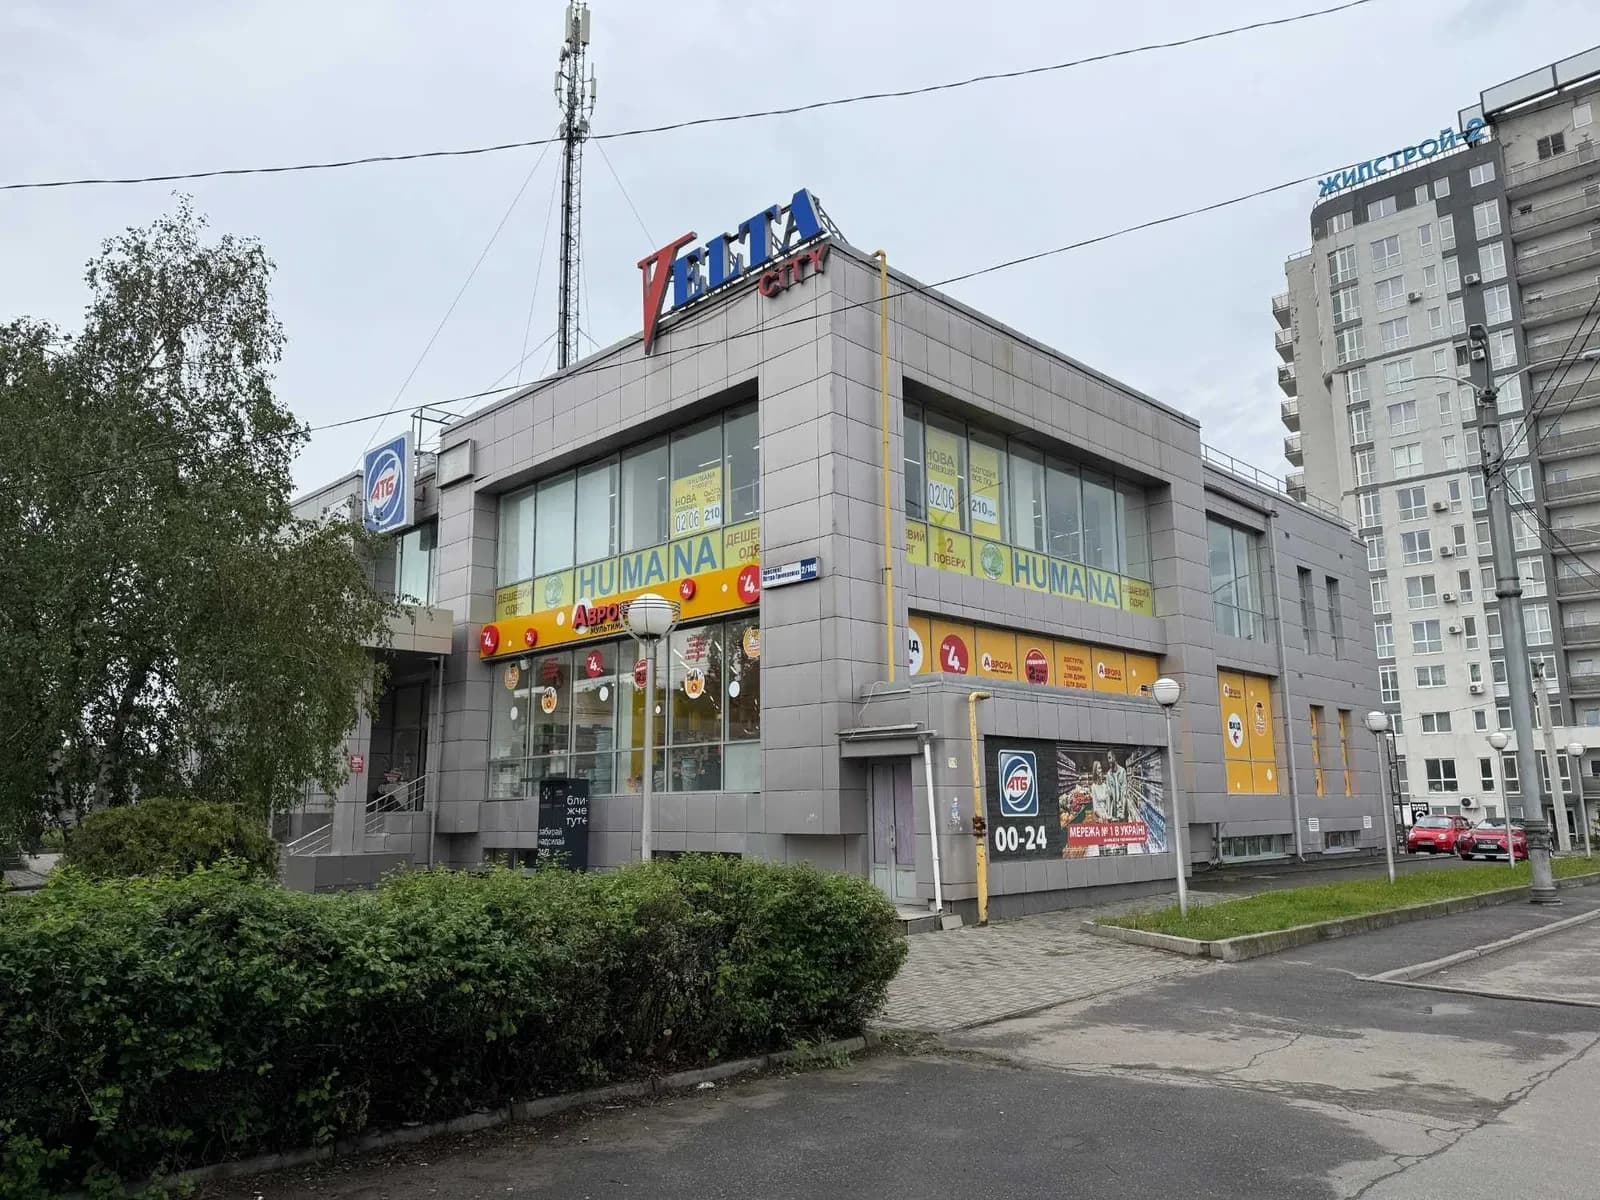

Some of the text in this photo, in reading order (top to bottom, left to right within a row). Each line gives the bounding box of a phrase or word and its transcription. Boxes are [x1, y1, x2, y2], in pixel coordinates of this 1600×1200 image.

[1318, 117, 1487, 197] ЖИЛСТРОЙ-2
[637, 188, 826, 355] VELTA
[758, 242, 829, 298] CITY
[371, 475, 394, 501] АТБ
[704, 506, 720, 522] 210
[971, 499, 987, 515] 210
[946, 537, 954, 554] 2
[579, 535, 717, 599] HUMANA
[933, 552, 966, 569] ПОВЕРХ
[744, 575, 755, 593] 4
[1014, 551, 1119, 606] HUMANA
[948, 645, 960, 671] 4
[983, 656, 1013, 670] АВРОРА
[1008, 776, 1028, 791] АТБ
[995, 825, 1048, 852] 00-24
[1069, 826, 1100, 838] МЕРЕЖА
